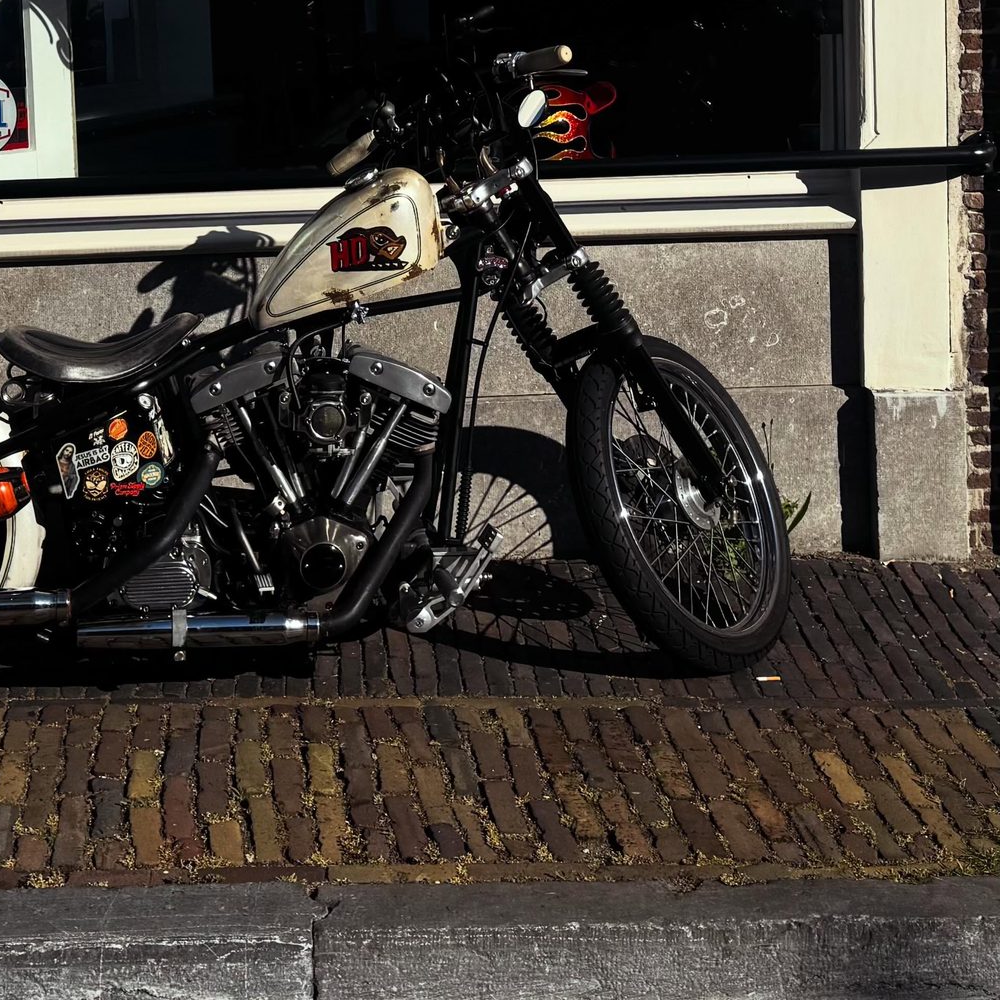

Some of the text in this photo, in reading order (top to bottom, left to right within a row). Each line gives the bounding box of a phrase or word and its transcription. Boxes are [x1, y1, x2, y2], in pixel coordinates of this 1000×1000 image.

[329, 235, 370, 271] HD
[75, 452, 92, 461] JESUS
[77, 453, 108, 468] AIRBAG
